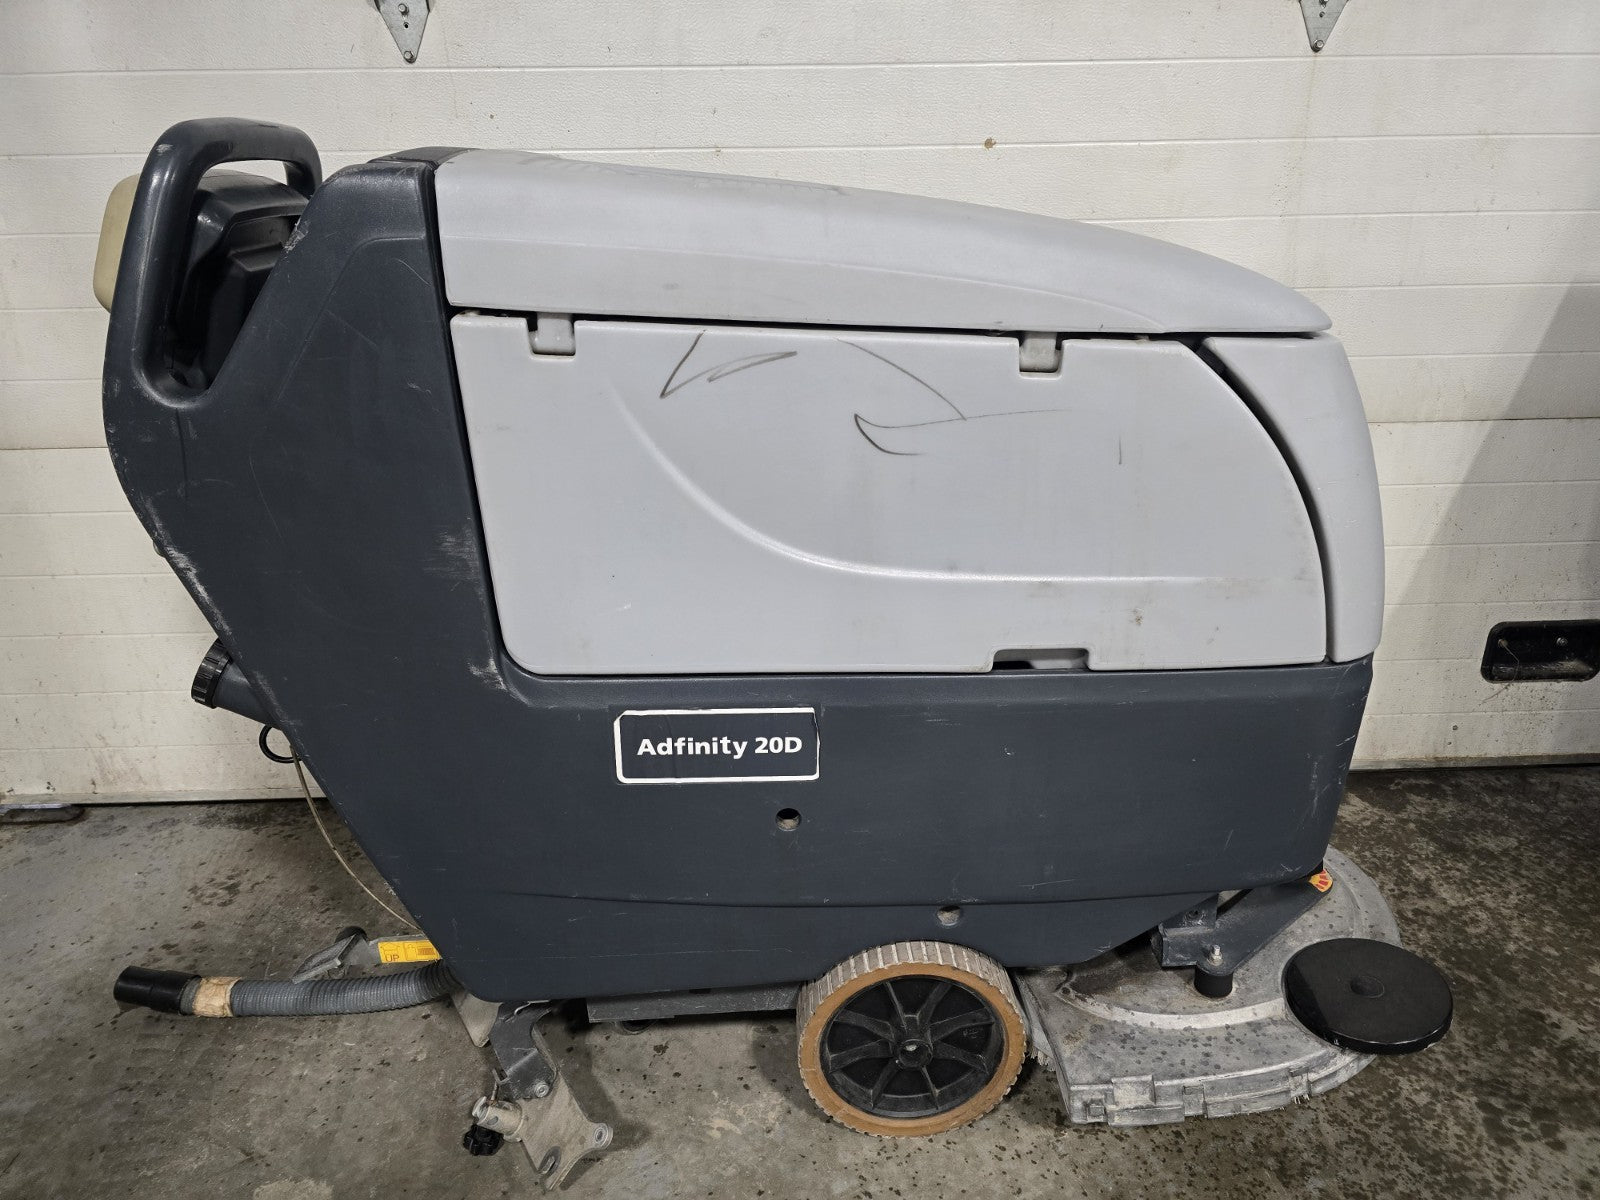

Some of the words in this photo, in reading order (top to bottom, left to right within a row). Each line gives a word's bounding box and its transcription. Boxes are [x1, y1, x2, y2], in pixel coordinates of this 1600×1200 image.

[637, 736, 747, 759] Adfinity
[754, 737, 802, 753] 20D
[385, 954, 400, 962] UP
